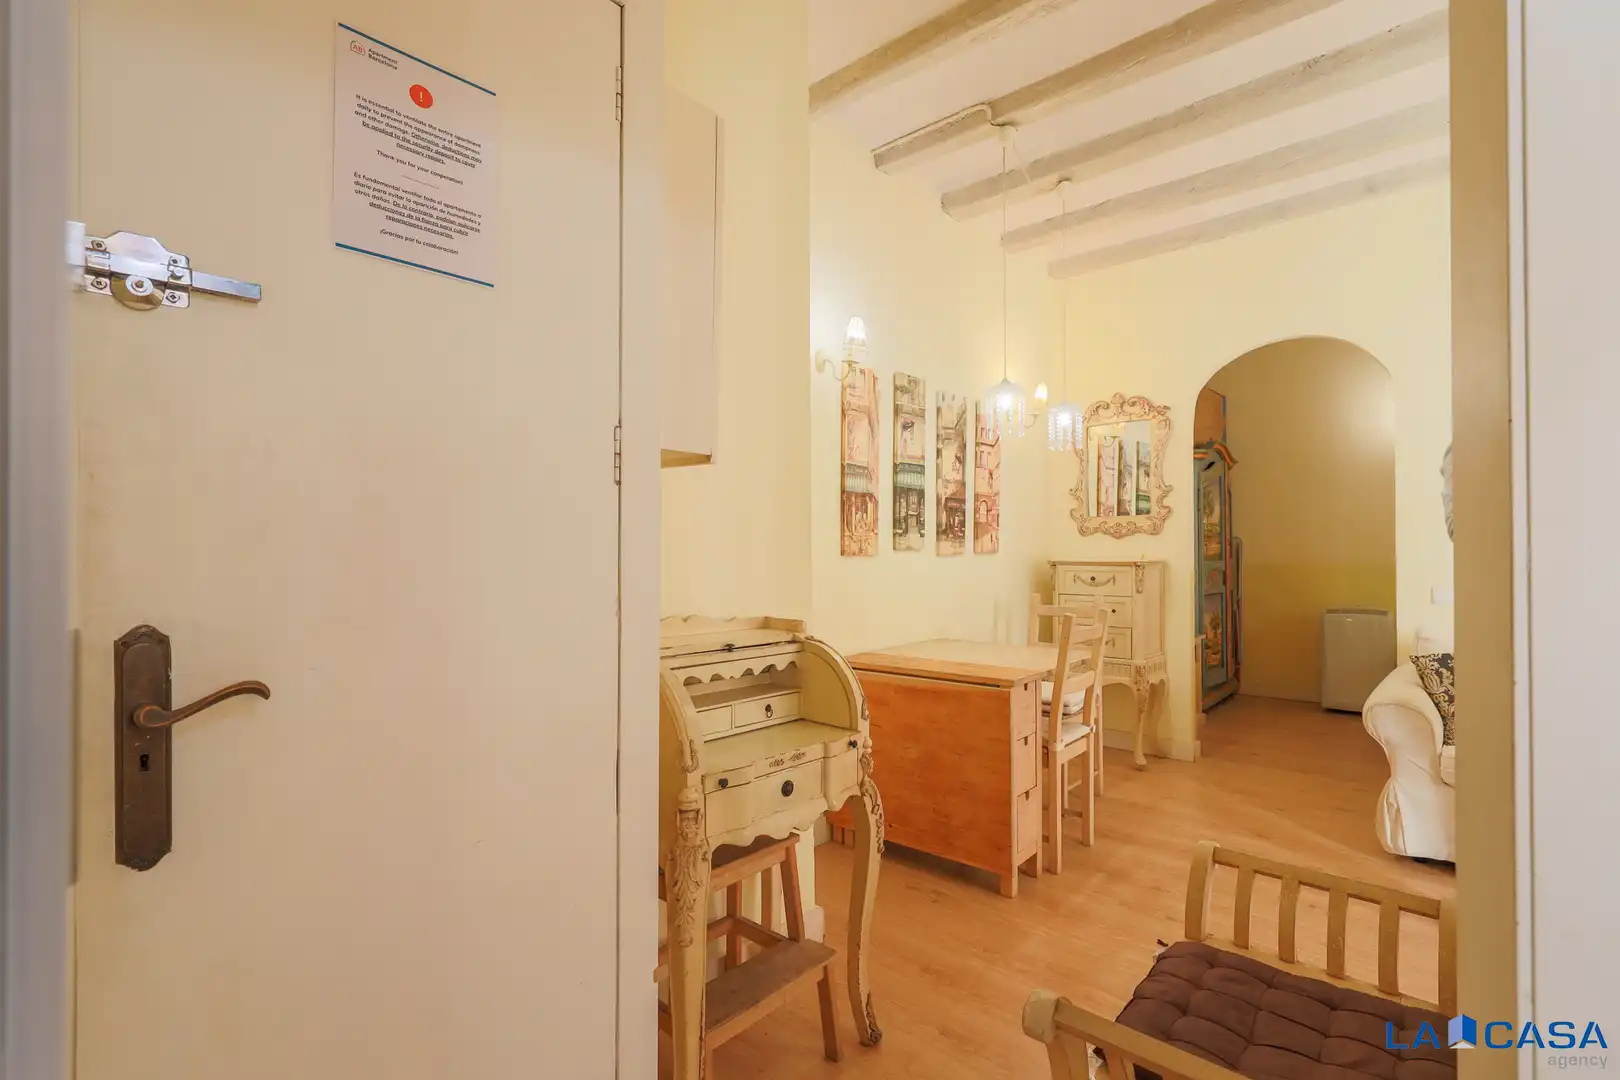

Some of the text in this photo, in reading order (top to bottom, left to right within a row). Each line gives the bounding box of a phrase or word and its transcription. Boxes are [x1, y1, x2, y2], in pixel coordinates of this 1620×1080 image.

[368, 48, 398, 65] Apartment
[368, 53, 398, 70] Barcelona
[354, 110, 367, 119] and
[367, 115, 384, 125] other
[470, 155, 482, 164] may
[356, 103, 372, 113] daily
[380, 112, 403, 125] prevent
[404, 121, 413, 130] the
[413, 126, 447, 143] appearance
[368, 100, 395, 114] essential
[402, 114, 428, 127] ventilate
[427, 123, 437, 131] the
[437, 128, 454, 138] entire
[453, 134, 481, 148] apartment
[362, 120, 371, 129] be
[371, 125, 394, 138] applied
[401, 136, 412, 145] the
[412, 140, 434, 153] security
[455, 156, 462, 164] to
[395, 142, 425, 158] necessary
[376, 149, 395, 160] Thank
[395, 157, 407, 165] you
[407, 160, 416, 168] for
[416, 165, 430, 173] your
[353, 171, 361, 179] Es
[362, 174, 401, 192] fundamental
[401, 188, 423, 199] ventilar
[423, 195, 437, 204] todo
[442, 202, 477, 217] apartamento
[353, 180, 372, 190] diario
[372, 187, 387, 196] para
[387, 192, 405, 201] evitar
[412, 200, 439, 212] aparición
[446, 210, 477, 226] humedades
[354, 189, 371, 198] otros
[392, 200, 402, 209] De
[402, 203, 408, 211] lo
[368, 201, 406, 218] deducciones
[406, 213, 414, 221] de
[414, 215, 422, 223] la
[421, 217, 440, 229] fianza
[440, 224, 454, 233] para
[385, 214, 423, 231] reparaciones
